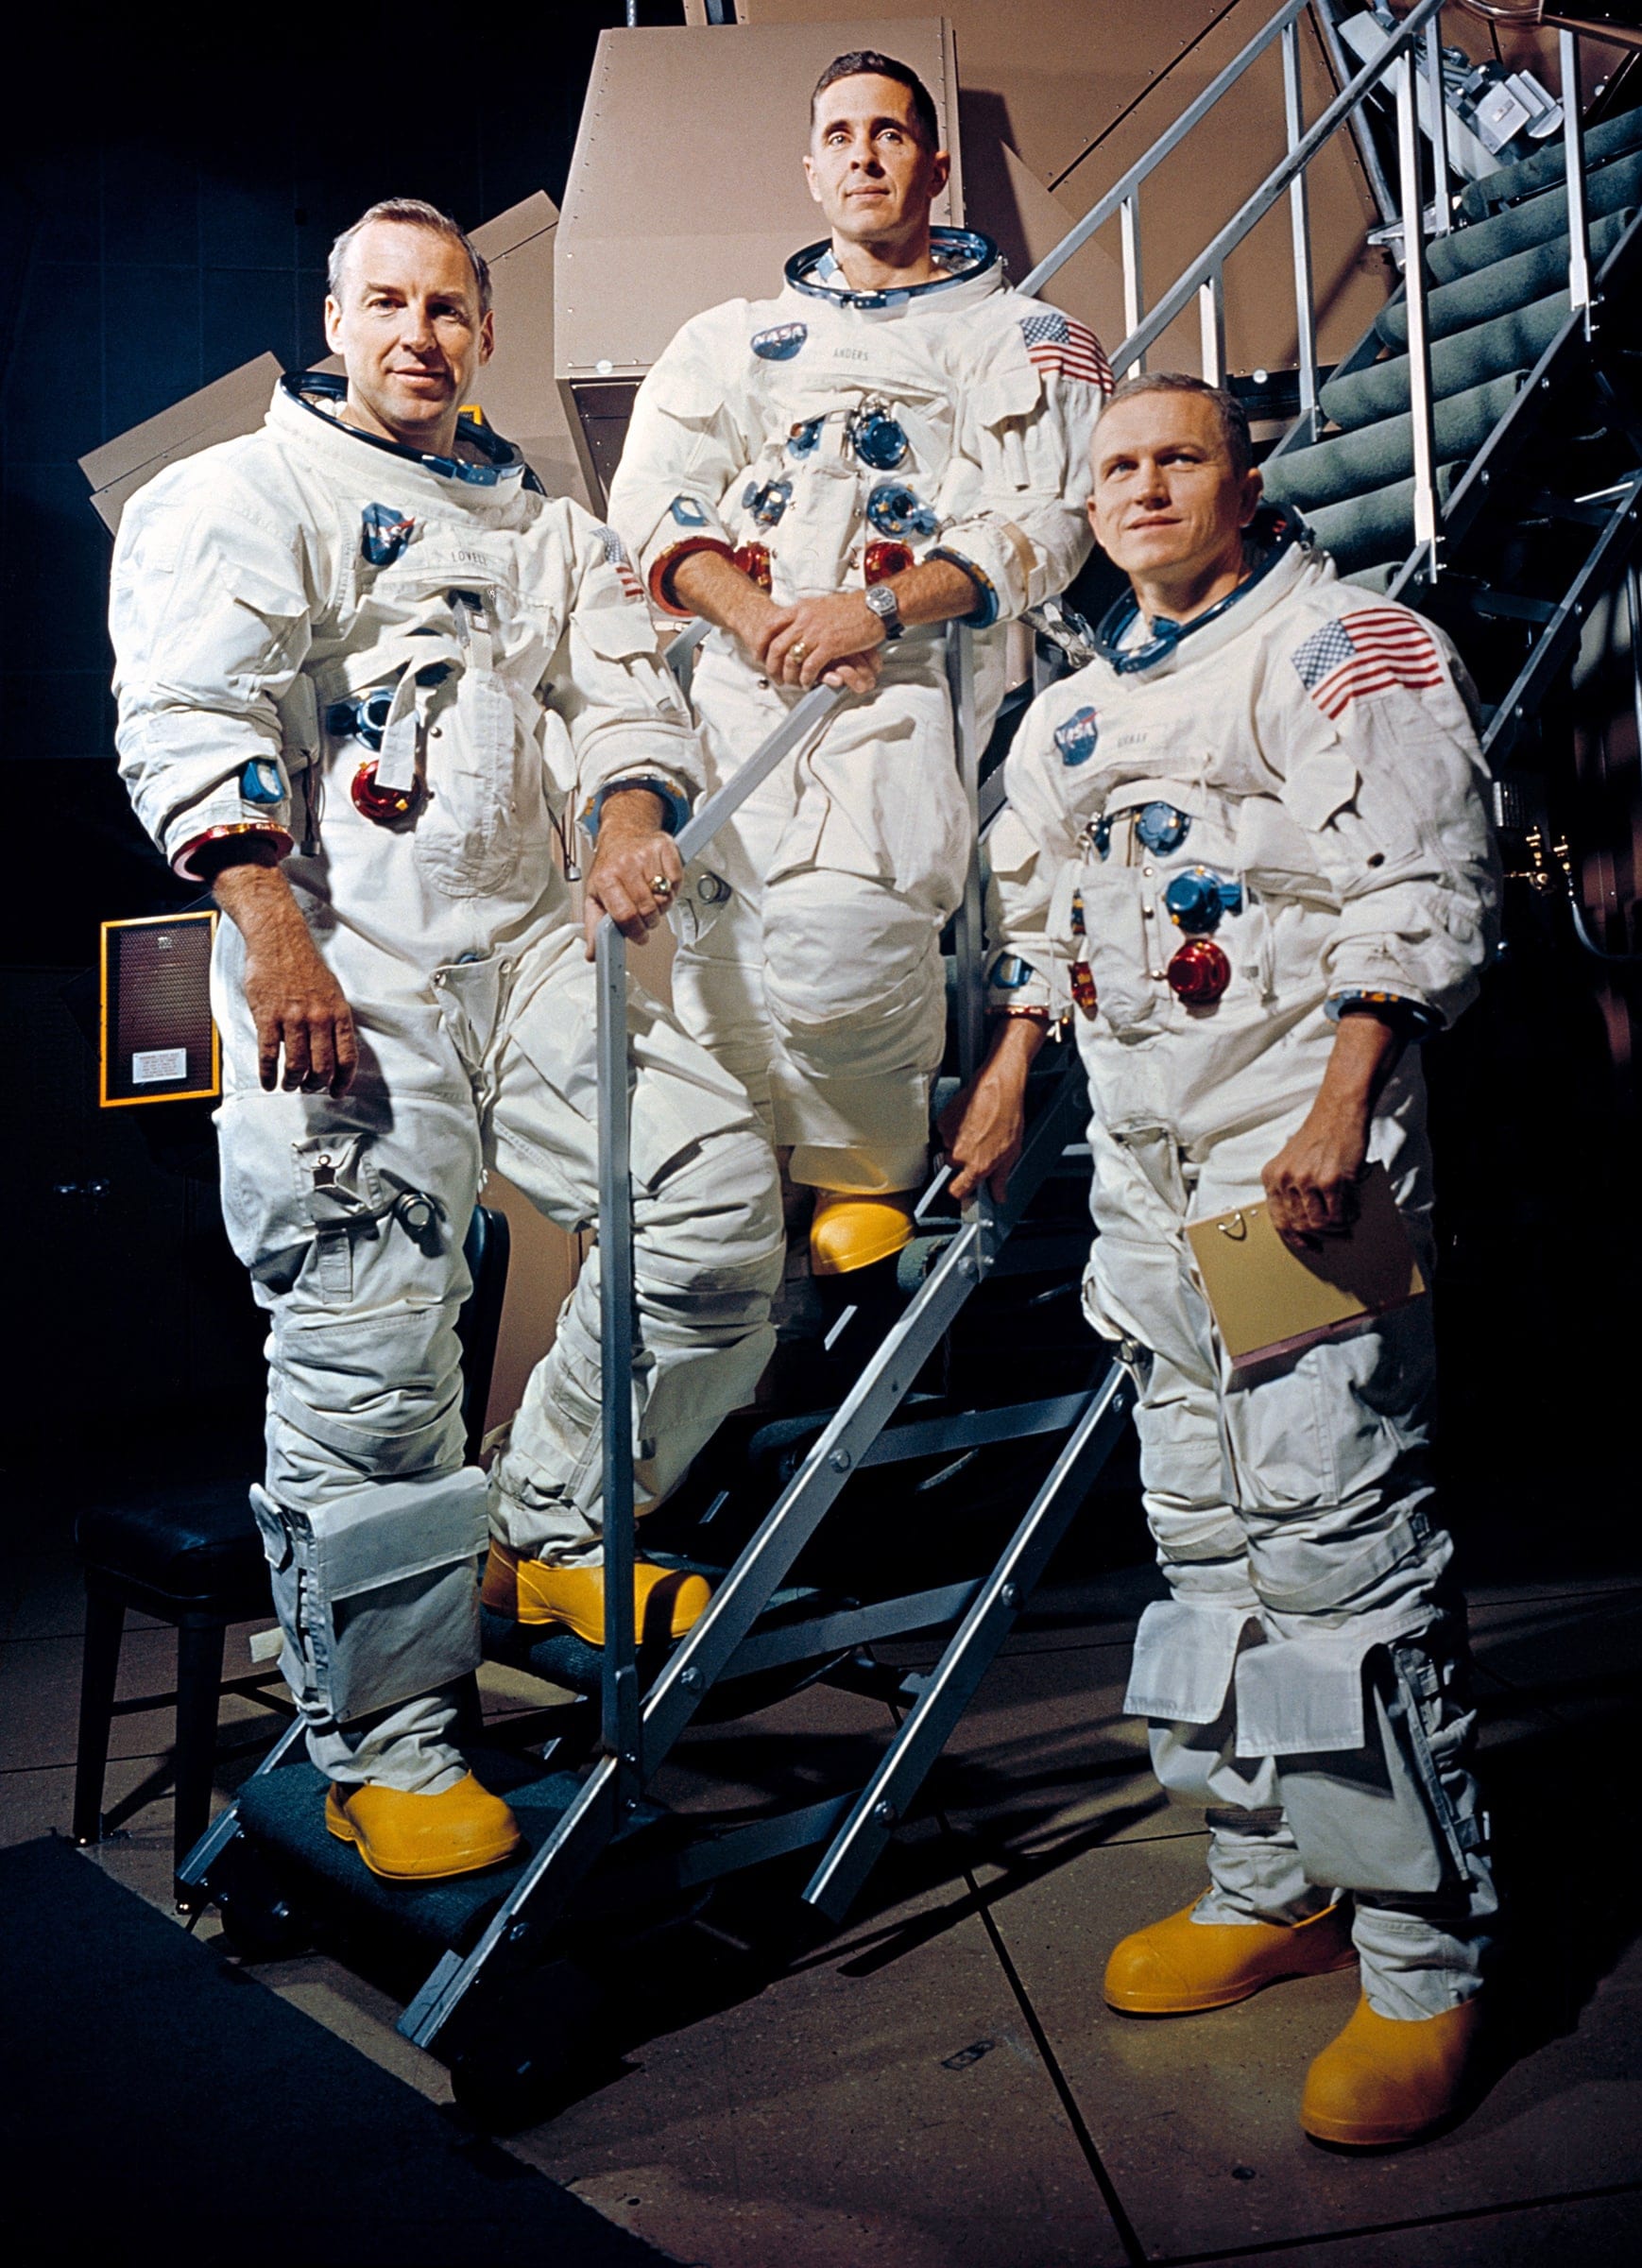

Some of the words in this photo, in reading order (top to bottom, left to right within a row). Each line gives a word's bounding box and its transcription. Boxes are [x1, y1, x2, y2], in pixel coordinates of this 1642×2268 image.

[754, 325, 804, 344] NASA
[832, 349, 868, 361] ANDERS
[452, 550, 487, 566] LOVELL
[1055, 723, 1095, 745] NASA
